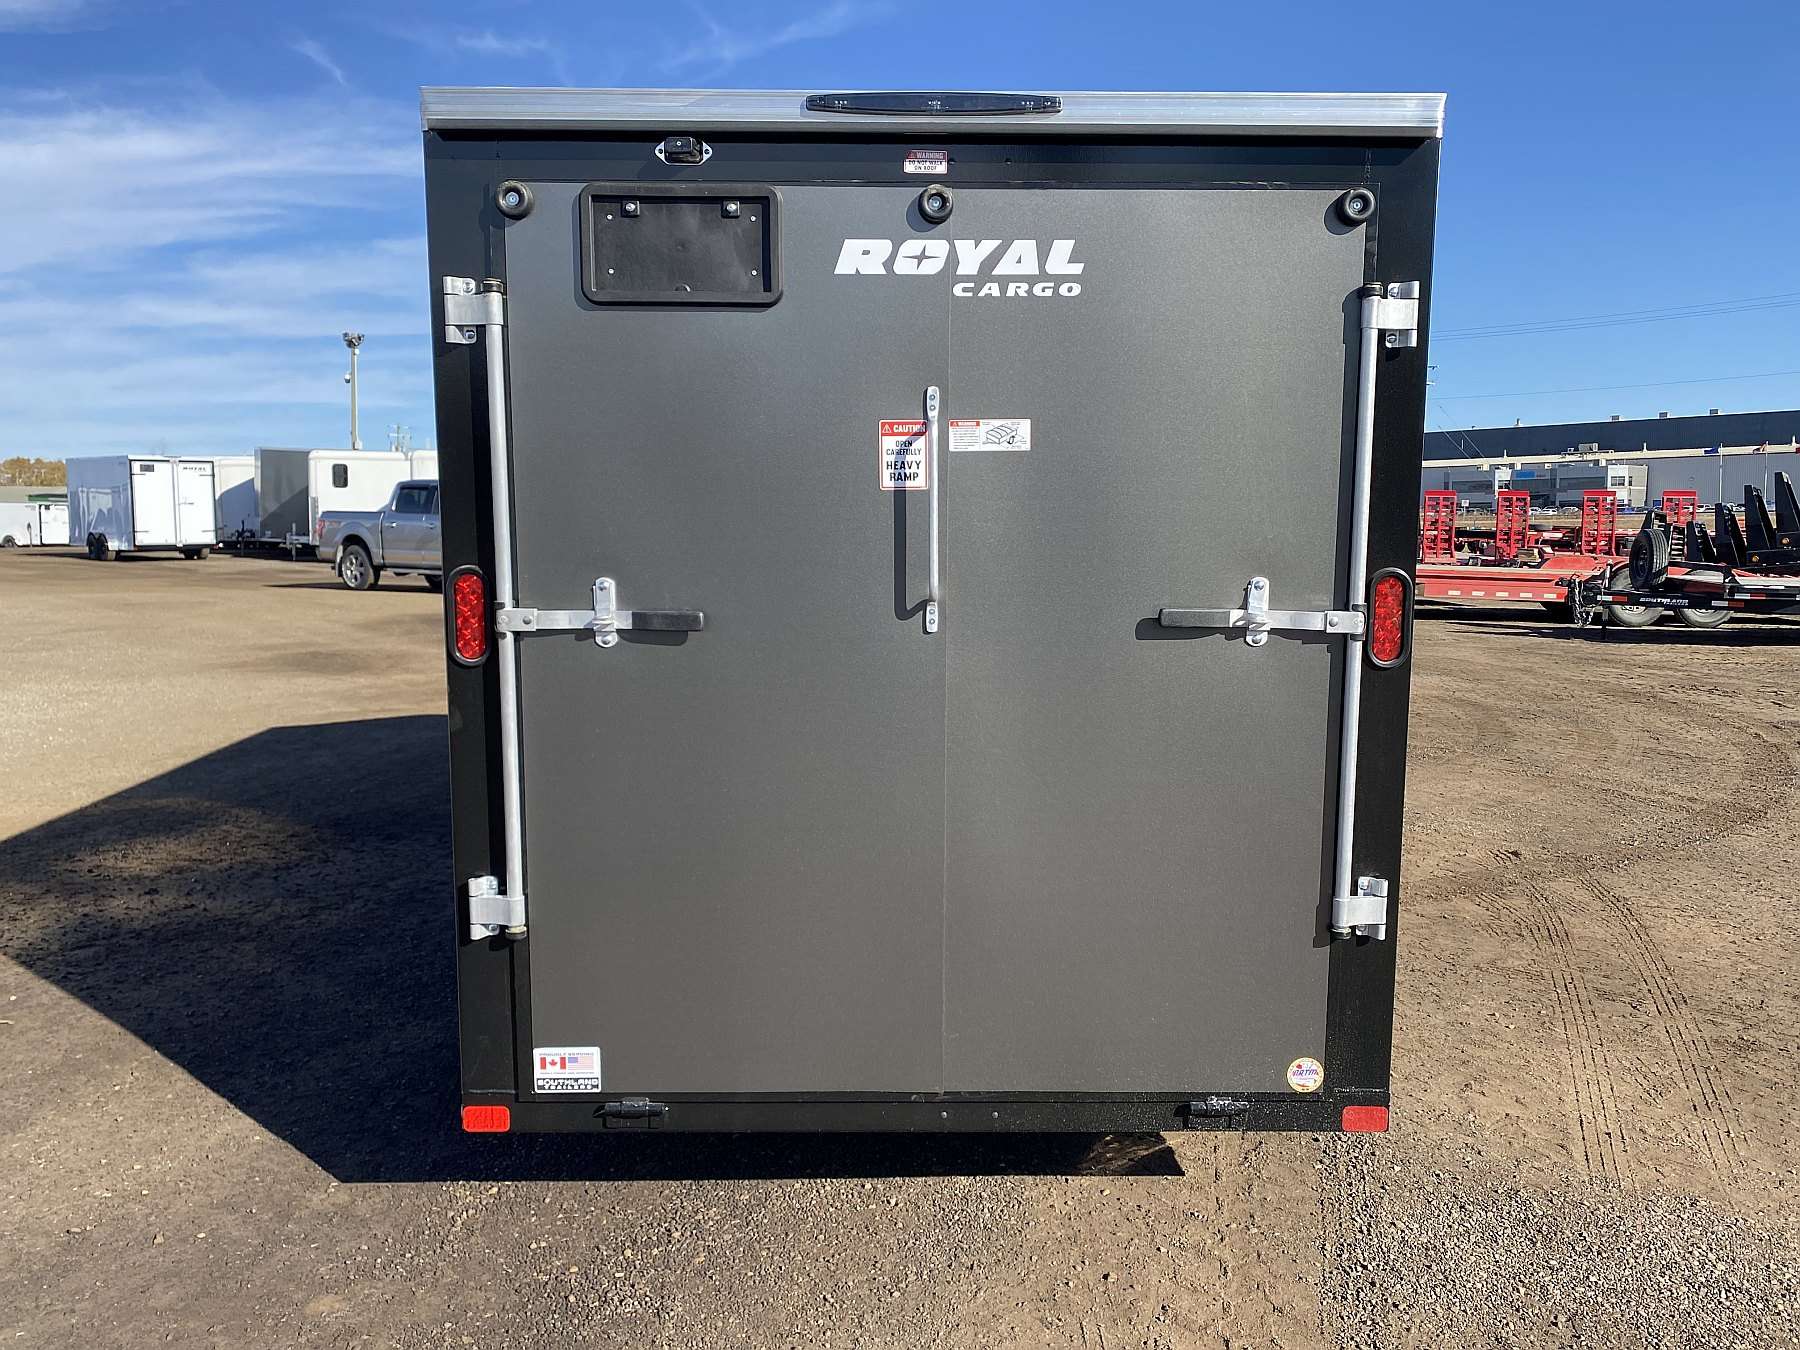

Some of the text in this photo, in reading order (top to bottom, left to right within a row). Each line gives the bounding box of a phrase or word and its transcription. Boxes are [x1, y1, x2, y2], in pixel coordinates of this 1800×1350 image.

[916, 151, 944, 159] WARNING
[833, 238, 1085, 275] ROYAL
[952, 282, 1082, 297] CARGO
[893, 424, 926, 433] CAUTION
[895, 440, 913, 448] OPEN
[886, 448, 922, 456] CAREFULLY
[886, 460, 922, 470] HEAVY
[889, 471, 919, 481] RAMP
[537, 1078, 599, 1086] SOUTHLAND
